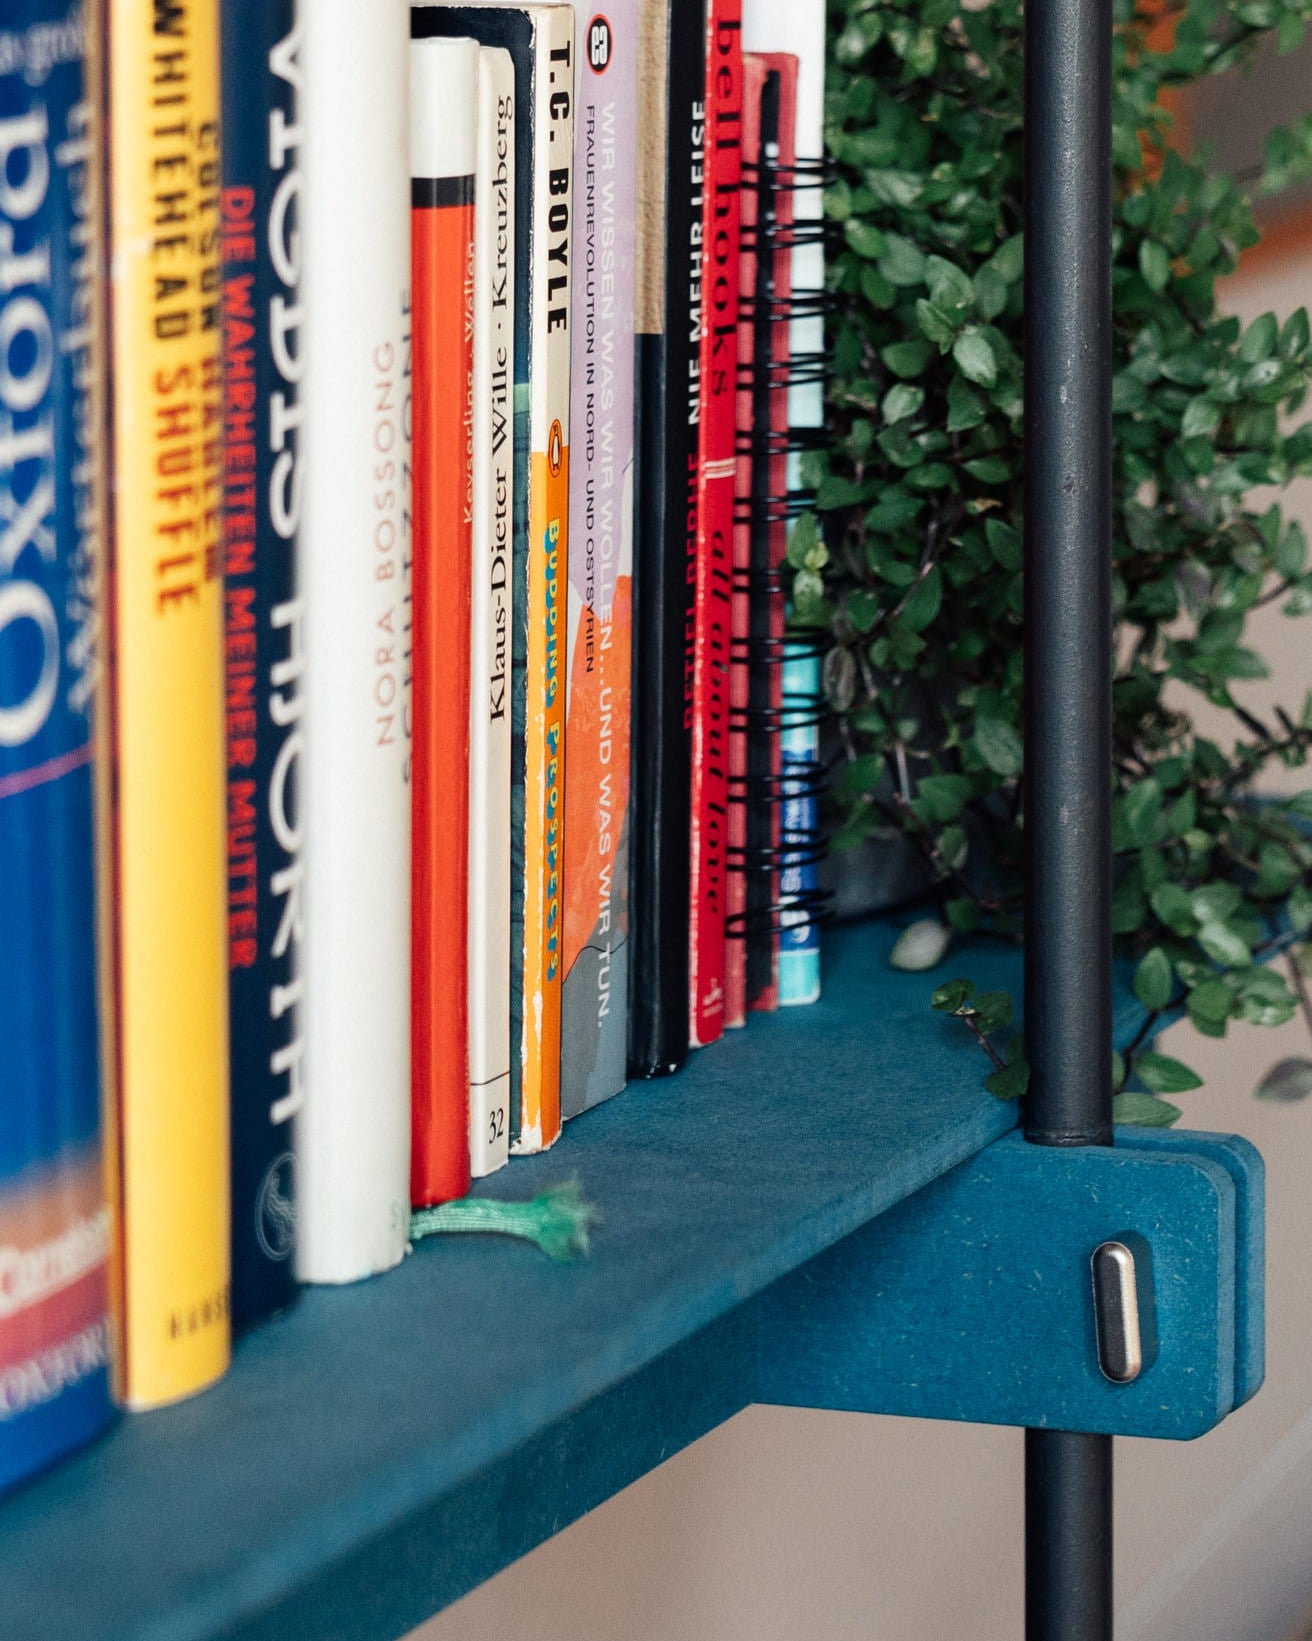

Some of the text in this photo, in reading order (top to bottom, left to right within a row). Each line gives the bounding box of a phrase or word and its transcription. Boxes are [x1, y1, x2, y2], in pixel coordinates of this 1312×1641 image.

[547, 40, 571, 335] T.C. BOYLE
[600, 180, 616, 320] WISSEN
[601, 101, 617, 171] WIR
[712, 20, 742, 396] bell hooks
[156, 363, 198, 622] SHUFFLE
[490, 94, 513, 725] Klaus-Dieter Wille Kreuzberg
[584, 104, 597, 674] FRAUENREVOLUTION IN NORD- UND OSTSYRIEN
[600, 329, 615, 411] WAS
[600, 419, 614, 490] WIR
[221, 185, 258, 968] DIE WAHRHEITEN MEINER MUTTER
[373, 340, 396, 747] NORA BOSSONG
[544, 518, 561, 978] BUDDING PROSPECTS
[598, 773, 612, 856] WAS
[706, 530, 731, 915] all about love
[597, 941, 612, 1028] TUN.
[598, 863, 612, 937] WIR
[488, 1108, 505, 1144] 32
